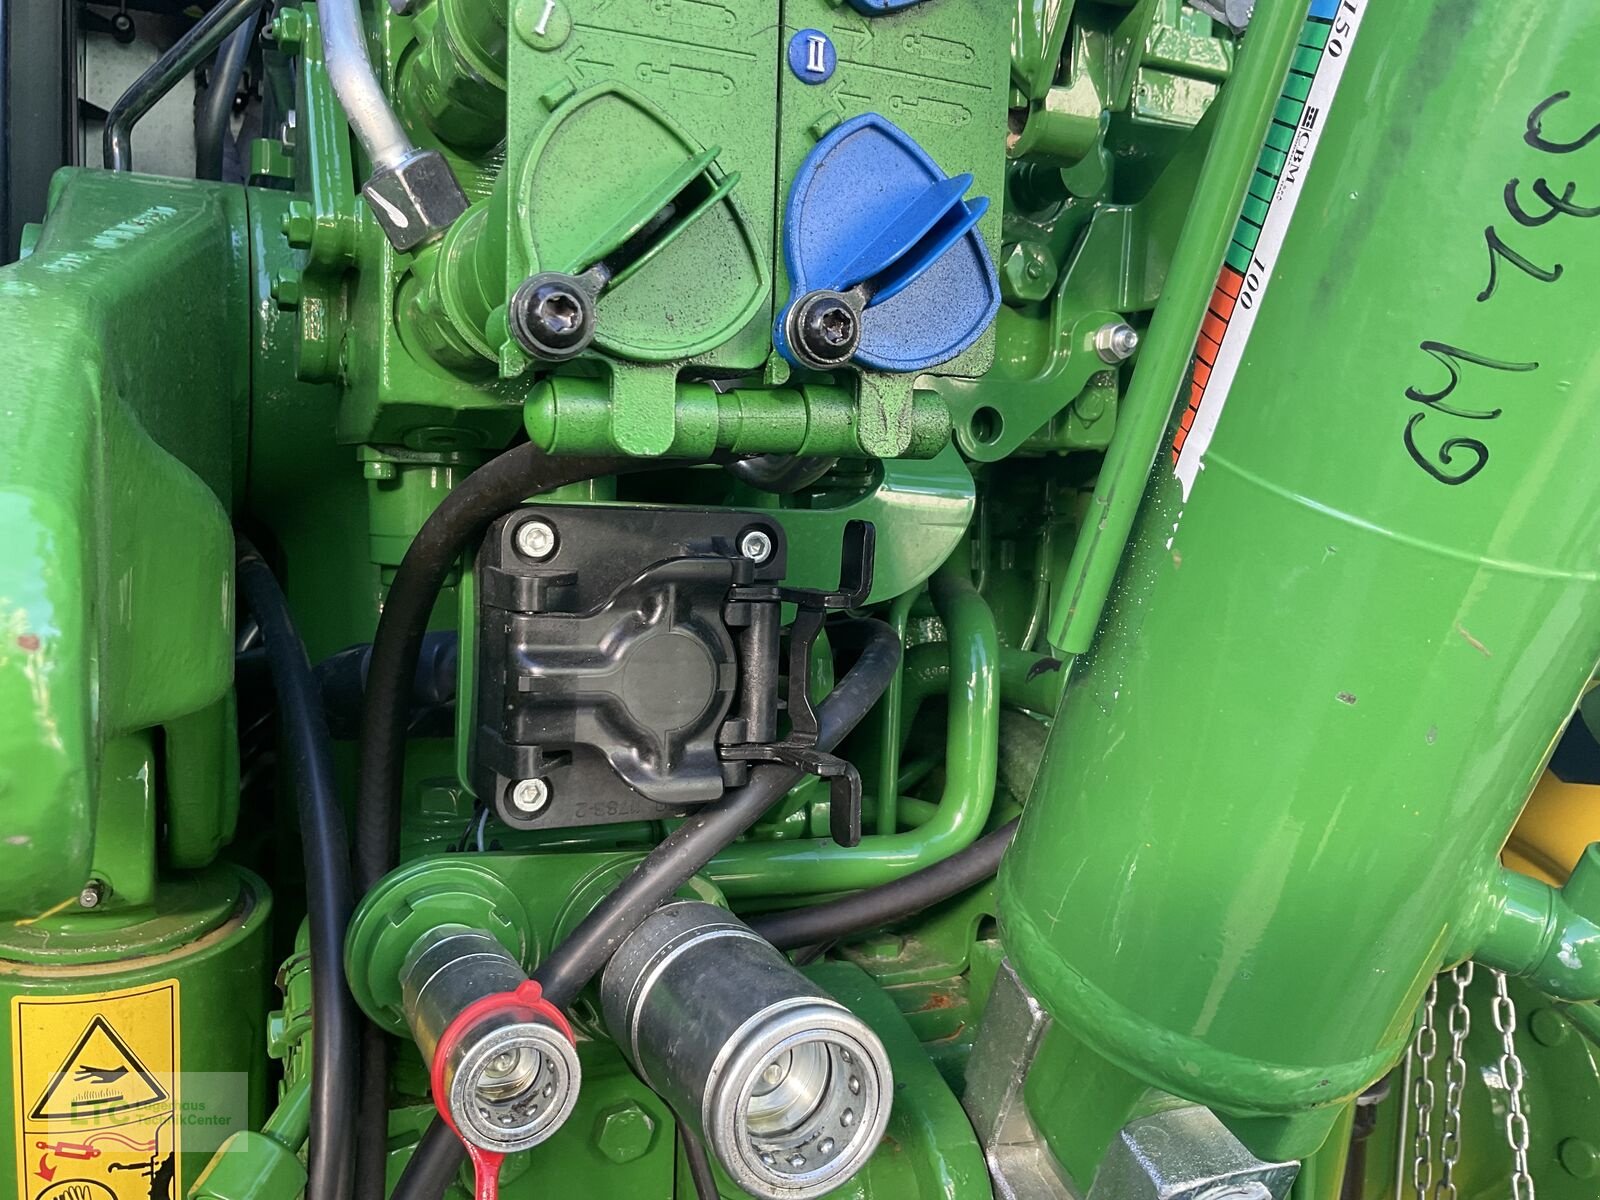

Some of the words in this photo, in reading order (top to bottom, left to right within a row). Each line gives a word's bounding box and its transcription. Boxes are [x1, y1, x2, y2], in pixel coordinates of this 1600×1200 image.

[805, 35, 827, 74] II
[1328, 0, 1358, 58] 150
[1286, 131, 1310, 184] CBM
[1240, 256, 1267, 310] 100
